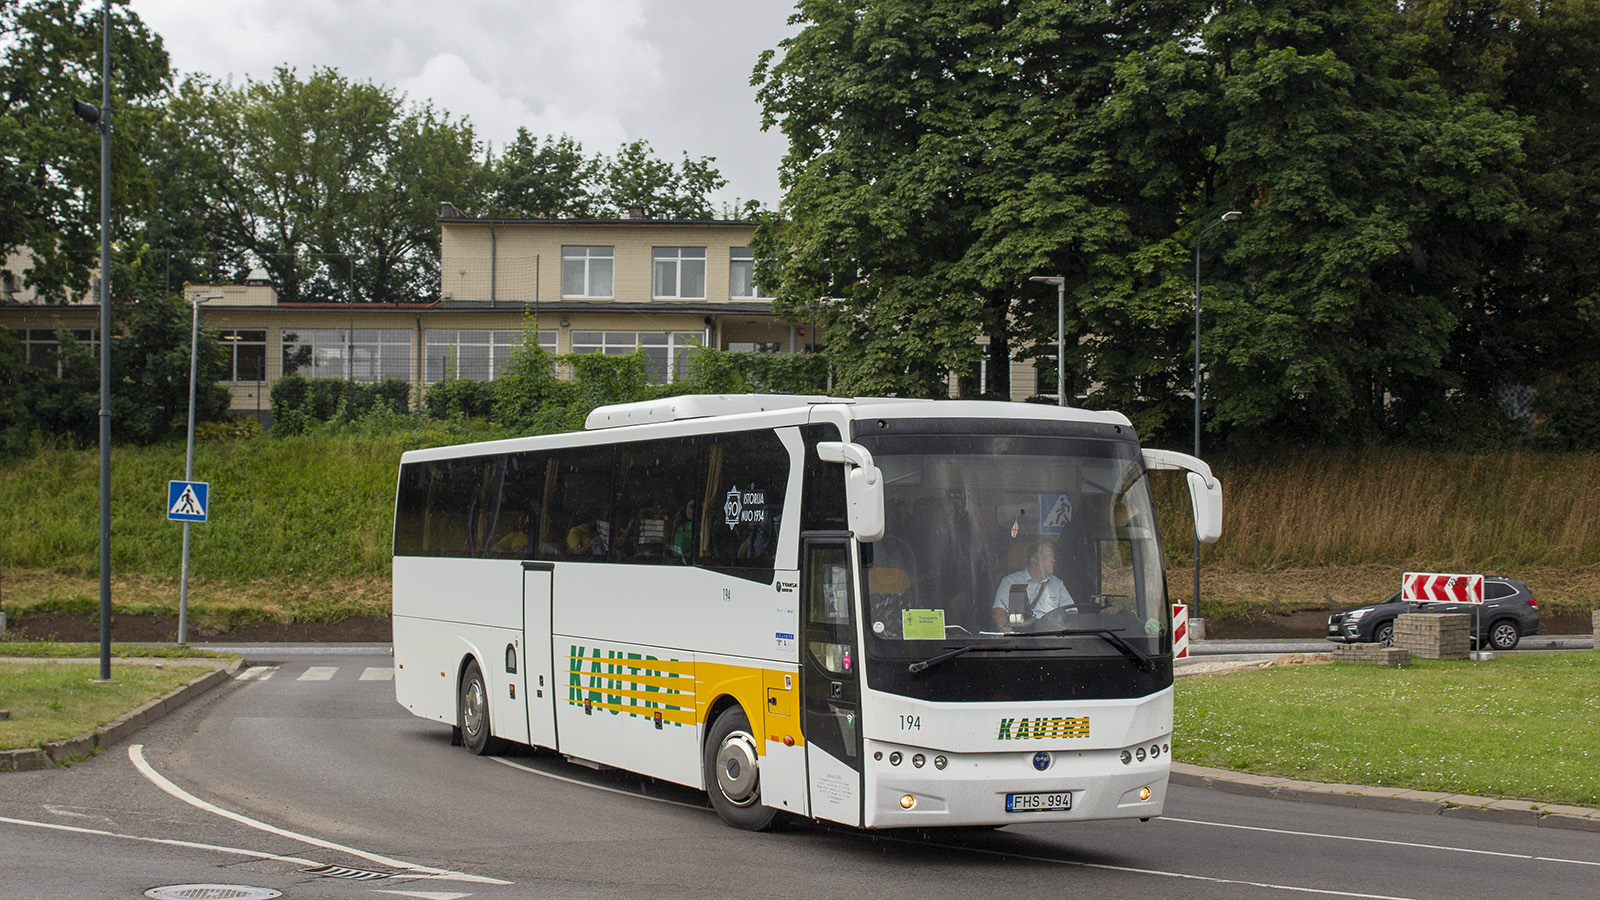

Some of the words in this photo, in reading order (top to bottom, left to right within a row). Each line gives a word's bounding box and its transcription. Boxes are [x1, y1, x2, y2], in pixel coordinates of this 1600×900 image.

[743, 493, 764, 505] ISTORIJA
[728, 501, 739, 517] 90
[741, 510, 753, 522] NUO
[753, 510, 765, 522] 1934
[722, 588, 731, 602] 194
[568, 645, 682, 728] KAUTRA
[900, 715, 921, 731] 194
[998, 716, 1090, 740] KAUTRA
[1014, 795, 1040, 808] FHS
[1047, 794, 1069, 807] 994
